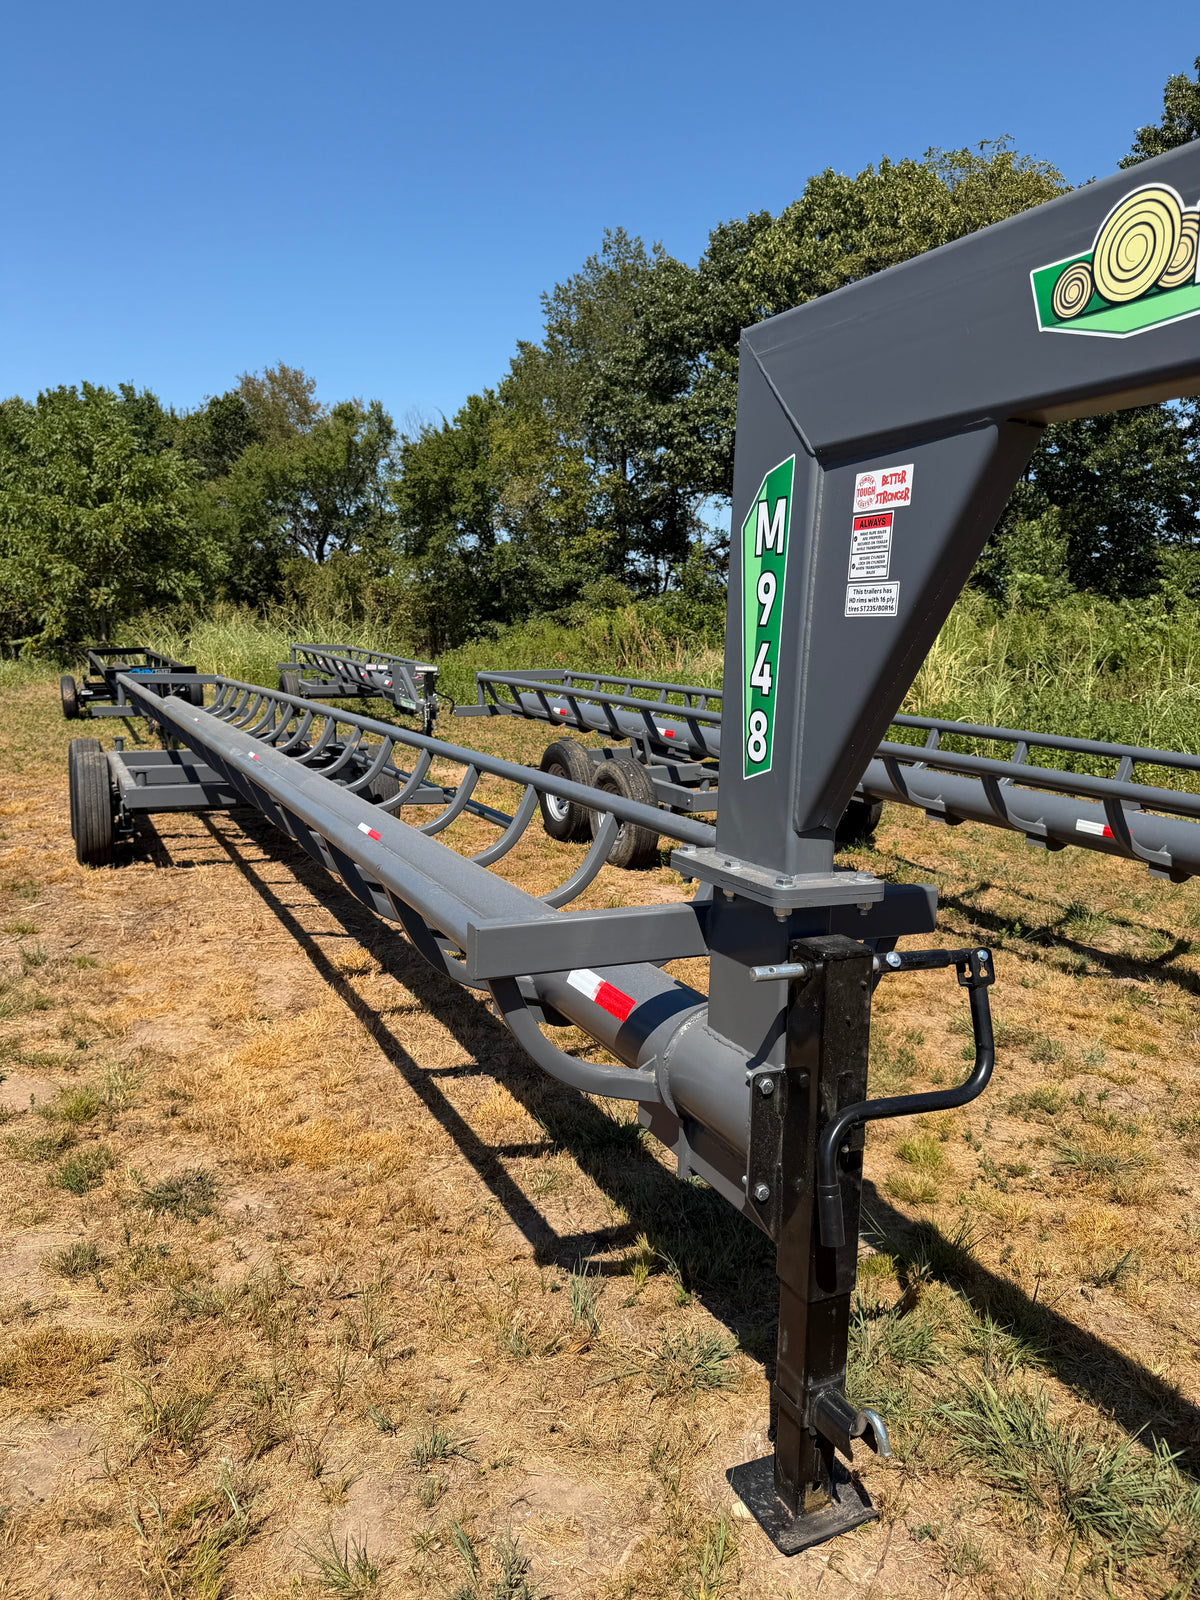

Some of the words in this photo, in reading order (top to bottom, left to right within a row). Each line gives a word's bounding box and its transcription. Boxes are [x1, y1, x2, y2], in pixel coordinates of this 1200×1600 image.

[882, 470, 906, 486] BETTER
[857, 486, 875, 497] TOUGH
[875, 487, 909, 504] STRONGER
[860, 518, 886, 528] ALWAYS
[747, 496, 788, 764] M948
